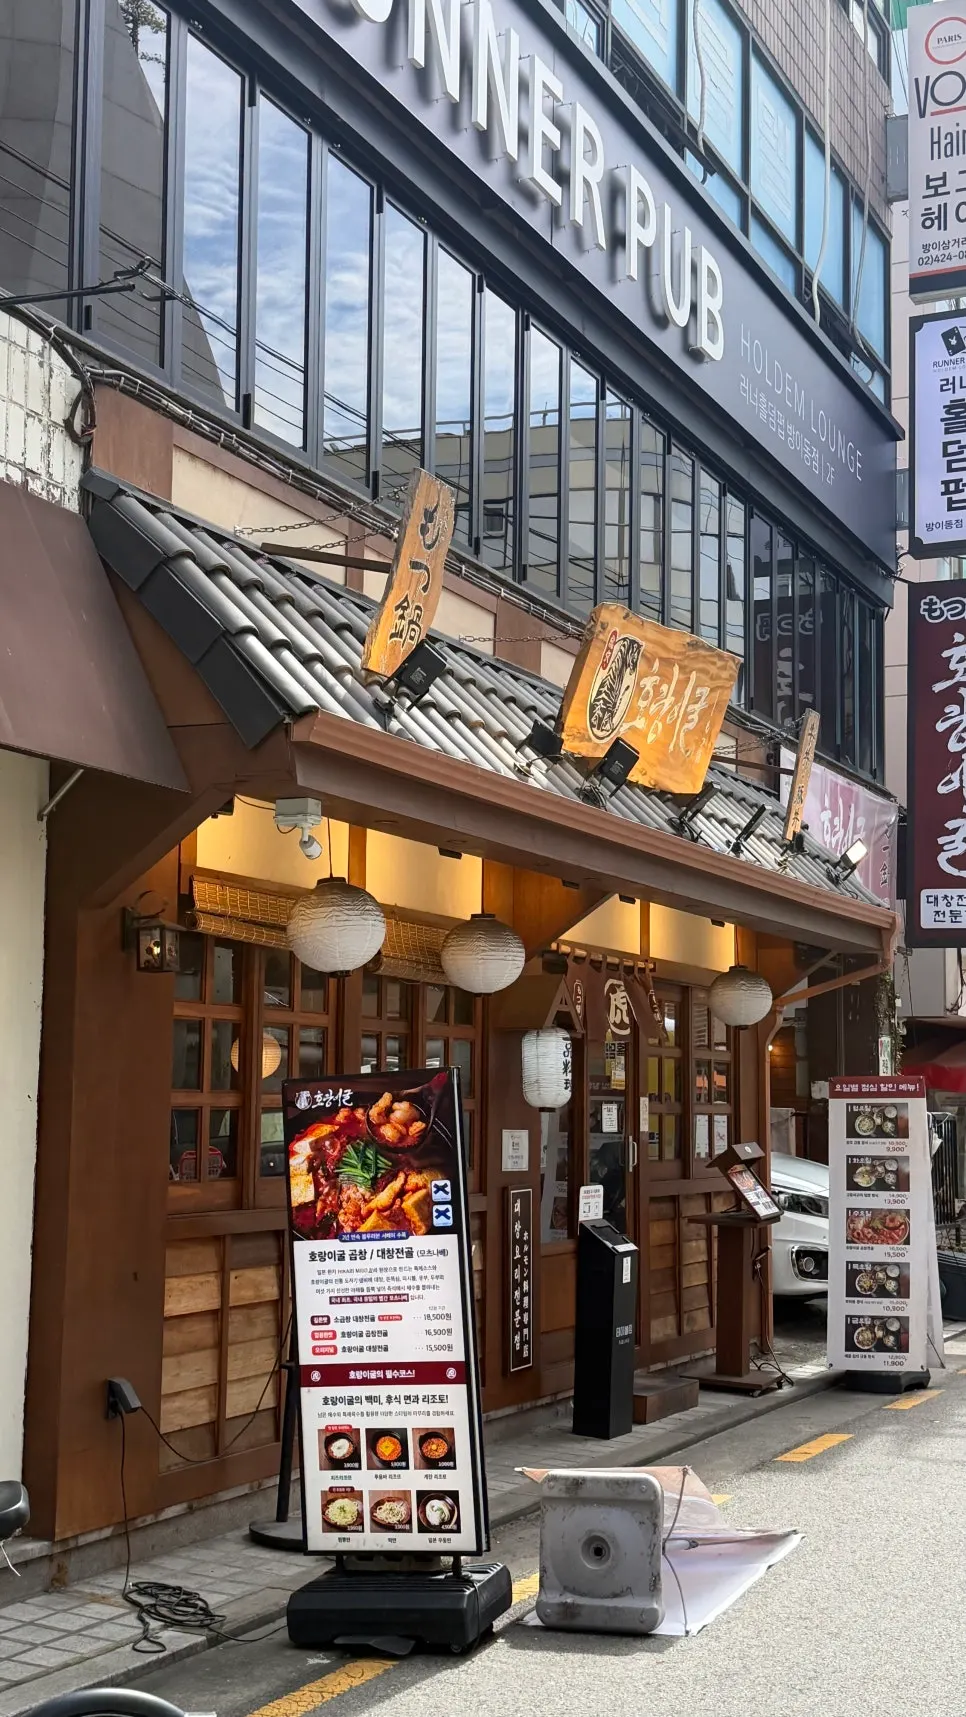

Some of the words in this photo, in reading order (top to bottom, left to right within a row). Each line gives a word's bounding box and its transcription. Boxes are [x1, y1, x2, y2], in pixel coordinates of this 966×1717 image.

[937, 33, 962, 45] PARIS
[352, 0, 606, 251] NNER
[625, 163, 724, 362] PUB
[932, 356, 965, 369] RUNNER
[741, 323, 805, 421] HOLDEM
[810, 400, 862, 481] LOUNGE
[740, 374, 785, 440] 러너홀덤펍
[787, 420, 818, 474] 방이동점
[925, 519, 963, 532] 방이동점
[620, 658, 711, 758] 호랑이굴
[834, 1083, 859, 1092] 요일별
[861, 1083, 878, 1092] 점심
[879, 1083, 897, 1092] 할인
[311, 1088, 353, 1108] 호랑이굴
[308, 1250, 346, 1262] 호랑이굴
[348, 1249, 367, 1261] 곱창
[376, 1247, 414, 1260] 대창전골
[416, 1248, 448, 1258] (모츠나베)
[424, 1313, 452, 1322] 18,500원
[425, 1328, 452, 1336] 16,500원
[426, 1344, 453, 1352] 15,500원
[349, 1370, 384, 1380] 호랑이굴의
[322, 1395, 362, 1406] 호랑이굴의
[365, 1395, 383, 1406] 백미,
[386, 1394, 401, 1404] 후식
[404, 1394, 420, 1404] 면과
[422, 1394, 449, 1404] 리조토!
